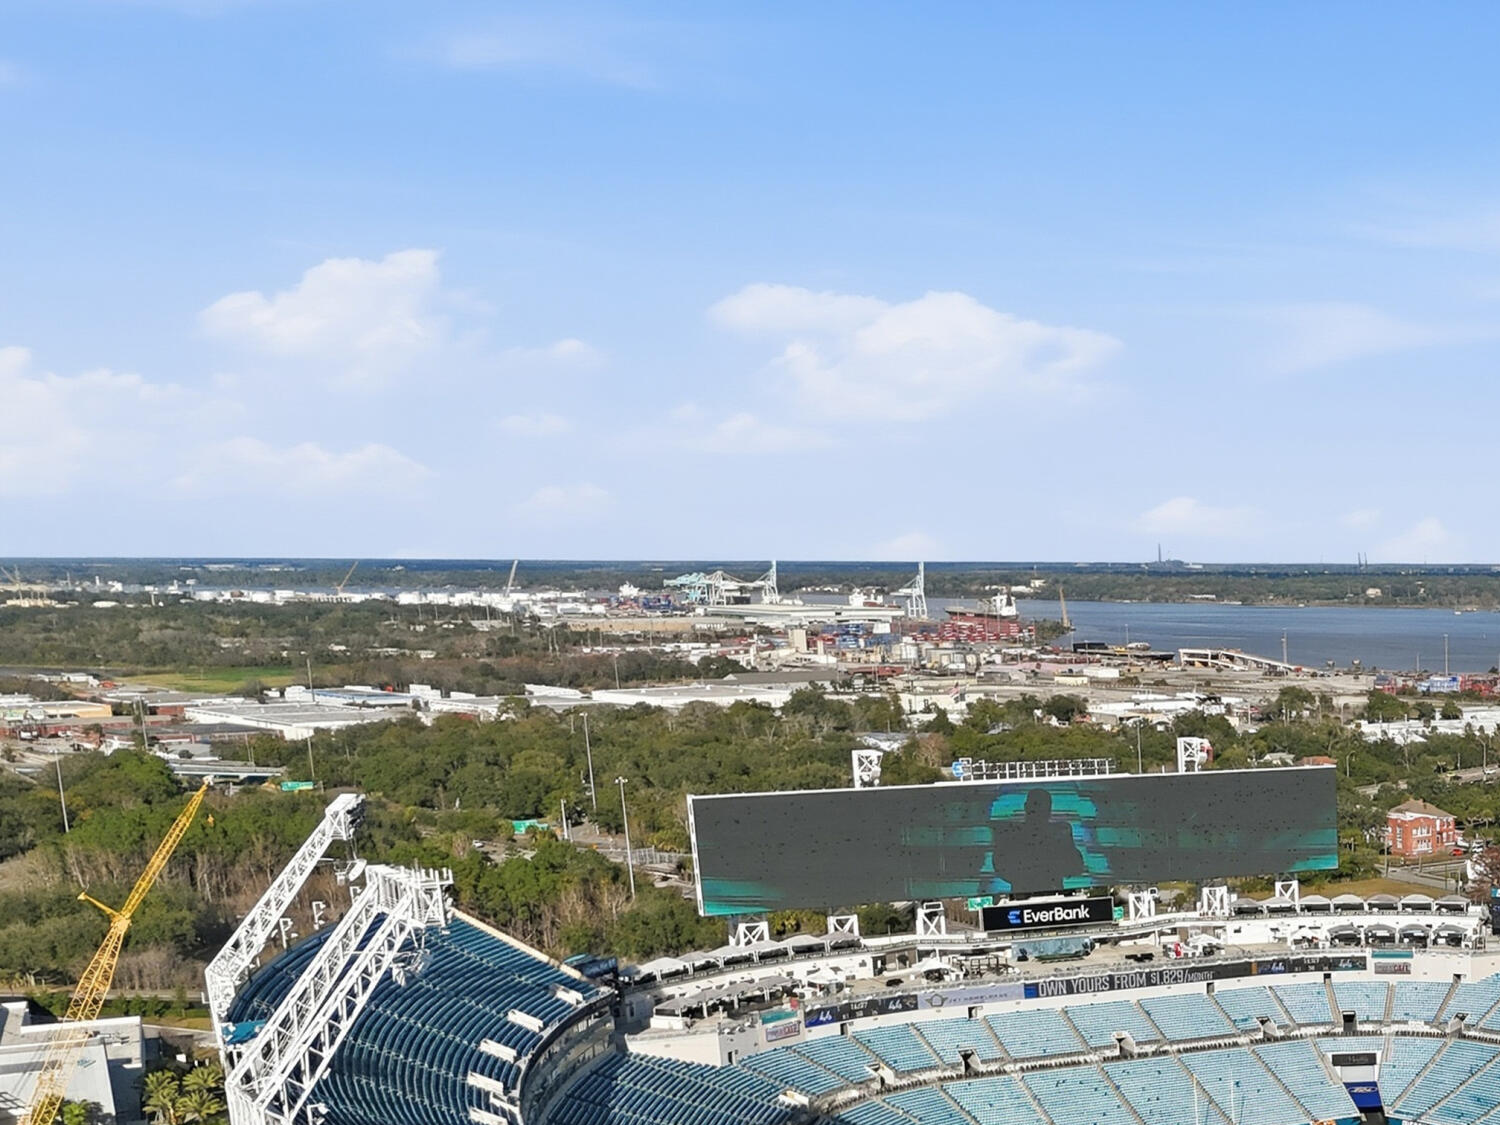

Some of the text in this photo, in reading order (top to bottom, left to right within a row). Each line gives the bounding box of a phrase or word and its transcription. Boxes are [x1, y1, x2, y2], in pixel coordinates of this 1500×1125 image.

[1023, 904, 1090, 924] EverBank
[1038, 980, 1067, 997] OWN
[1072, 975, 1110, 993] YOURS
[1114, 970, 1147, 989] FROM
